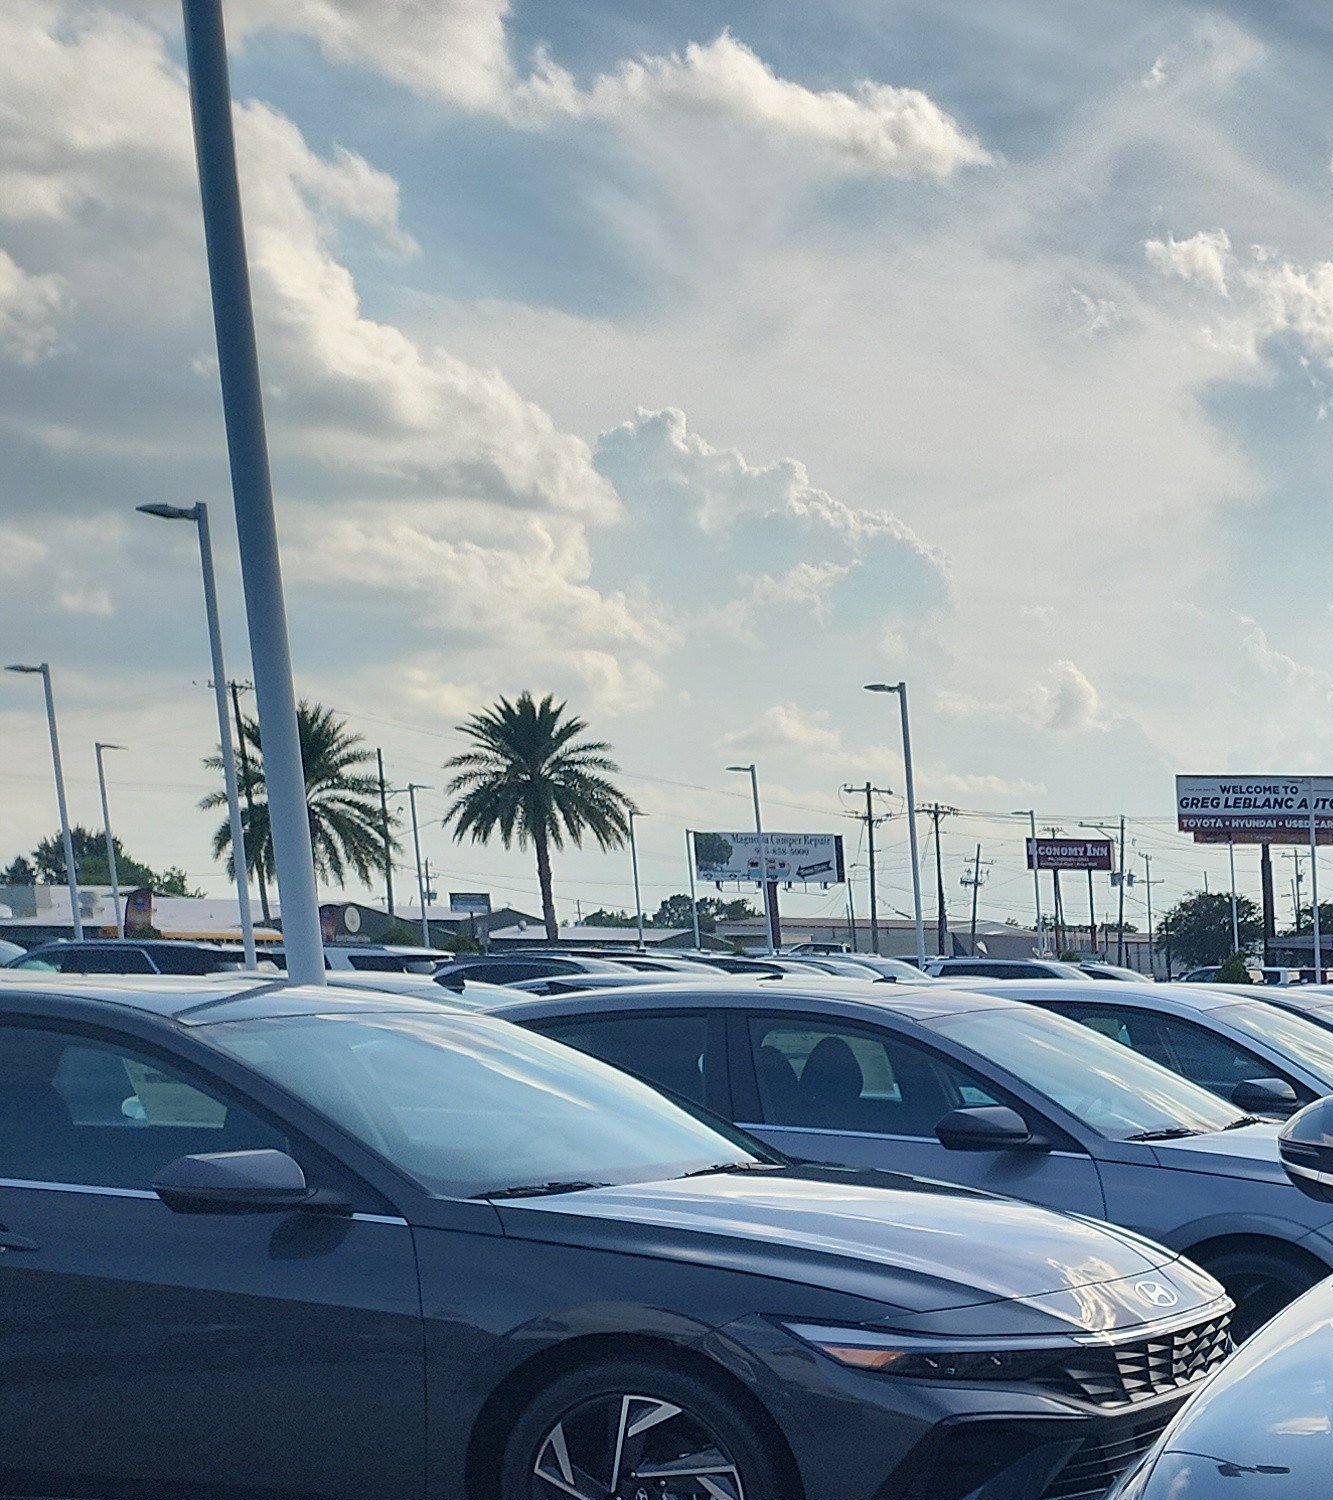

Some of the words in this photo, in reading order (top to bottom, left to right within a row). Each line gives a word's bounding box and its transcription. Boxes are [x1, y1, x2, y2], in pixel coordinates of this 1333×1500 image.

[1219, 785, 1279, 795] WELCOME
[1282, 785, 1299, 795] TO
[1179, 796, 1221, 809] GREG
[1223, 797, 1295, 810] LEBLANC
[1181, 818, 1224, 828] TOYOTA
[1231, 819, 1277, 828] HYUNDAI
[1285, 819, 1311, 829] USED
[731, 833, 769, 846] Magnoia
[770, 834, 801, 847] Camper
[803, 834, 831, 847] Repair
[1085, 843, 1108, 856] INN
